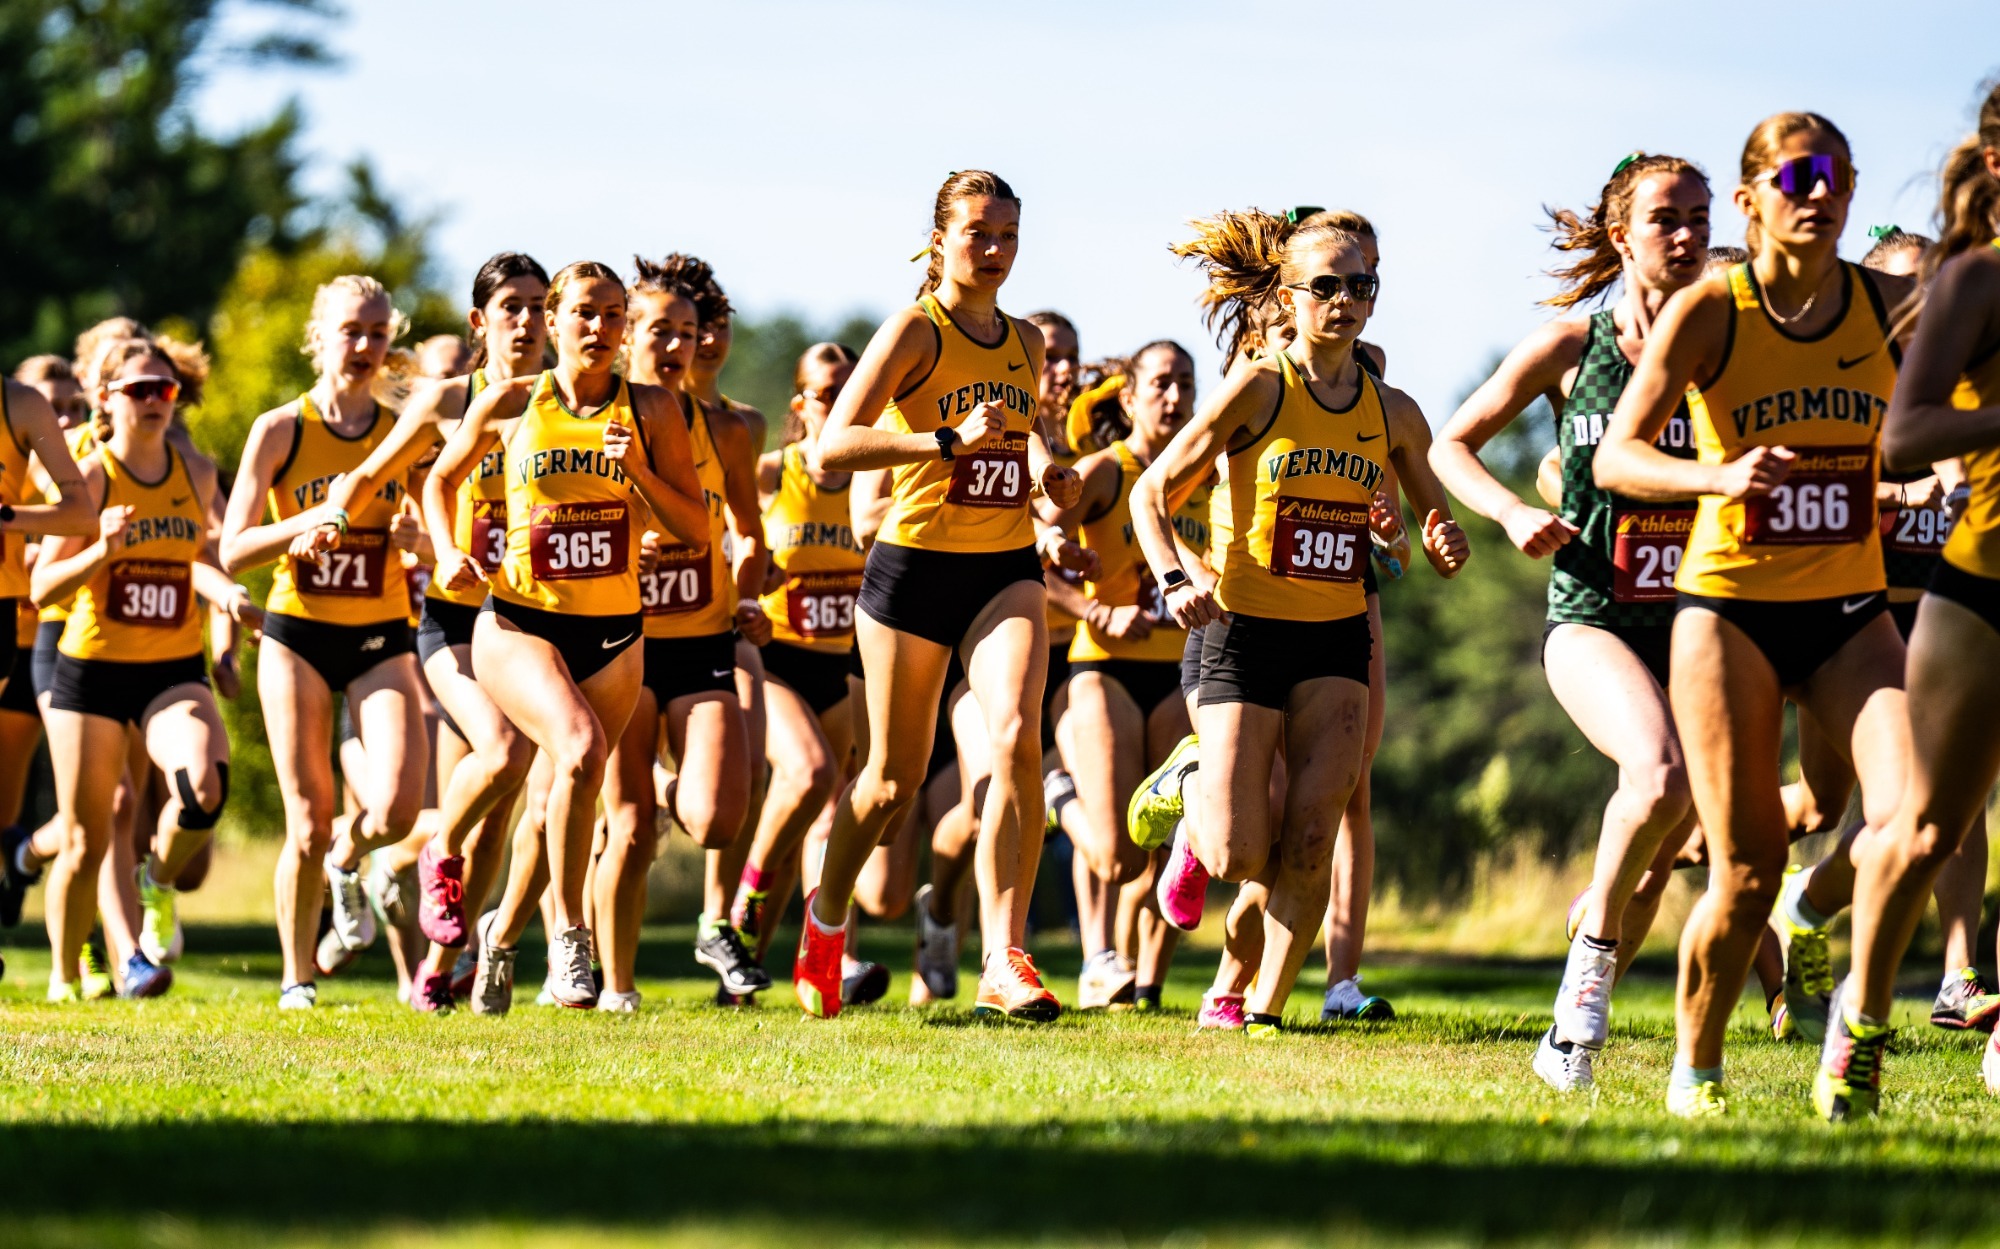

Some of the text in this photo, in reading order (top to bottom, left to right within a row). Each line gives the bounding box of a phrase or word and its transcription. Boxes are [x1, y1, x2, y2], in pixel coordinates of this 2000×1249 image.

[518, 448, 635, 494] VERMON
[968, 460, 1020, 498] 379
[1768, 483, 1849, 532] 366
[1896, 509, 1951, 544] 295
[125, 516, 201, 548] ERMON
[547, 531, 613, 570] 365
[1291, 529, 1357, 572] 395
[312, 553, 369, 588] 371
[640, 567, 699, 606] 370
[122, 583, 177, 618] 390
[801, 594, 855, 630] 363
